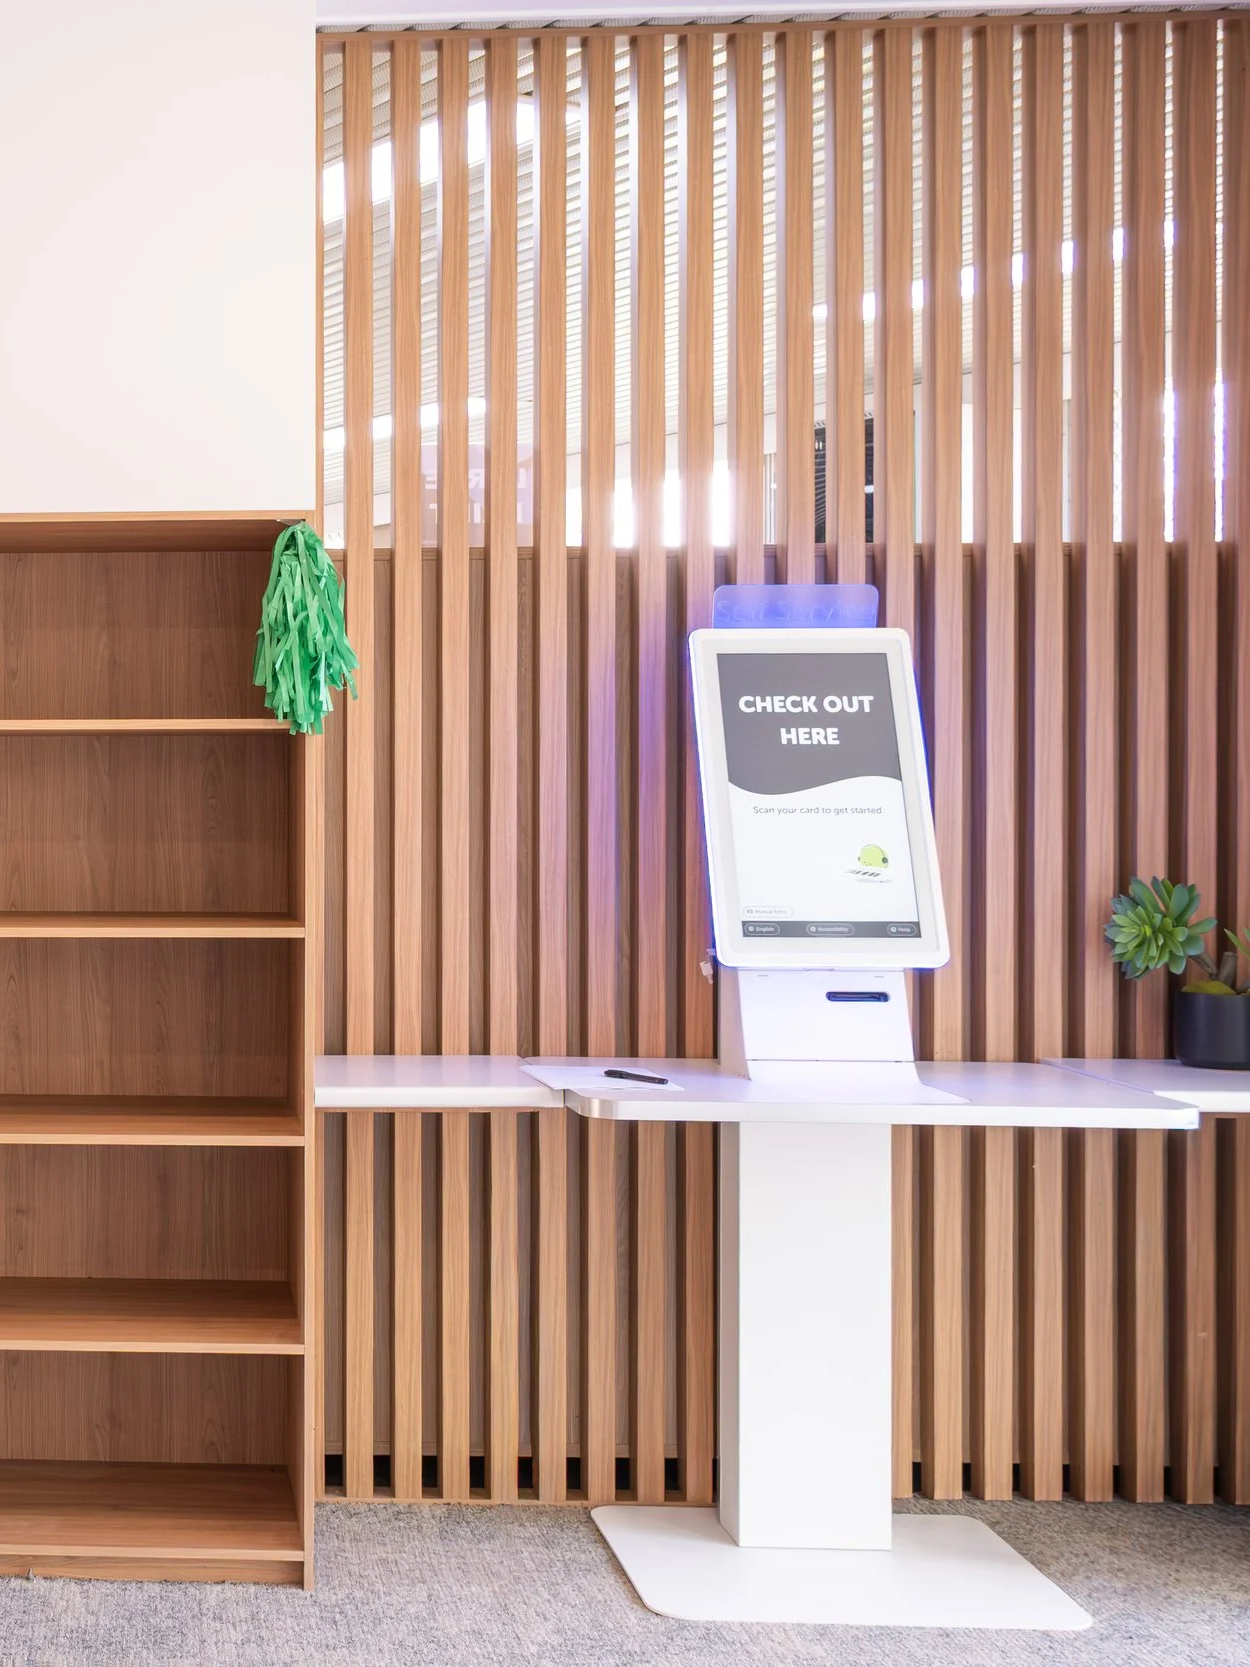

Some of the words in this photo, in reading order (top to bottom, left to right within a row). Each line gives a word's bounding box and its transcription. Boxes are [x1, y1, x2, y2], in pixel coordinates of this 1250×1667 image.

[738, 695, 818, 713] CHECK
[822, 695, 874, 713] OUT
[780, 728, 840, 745] HERE
[834, 807, 848, 815] get
